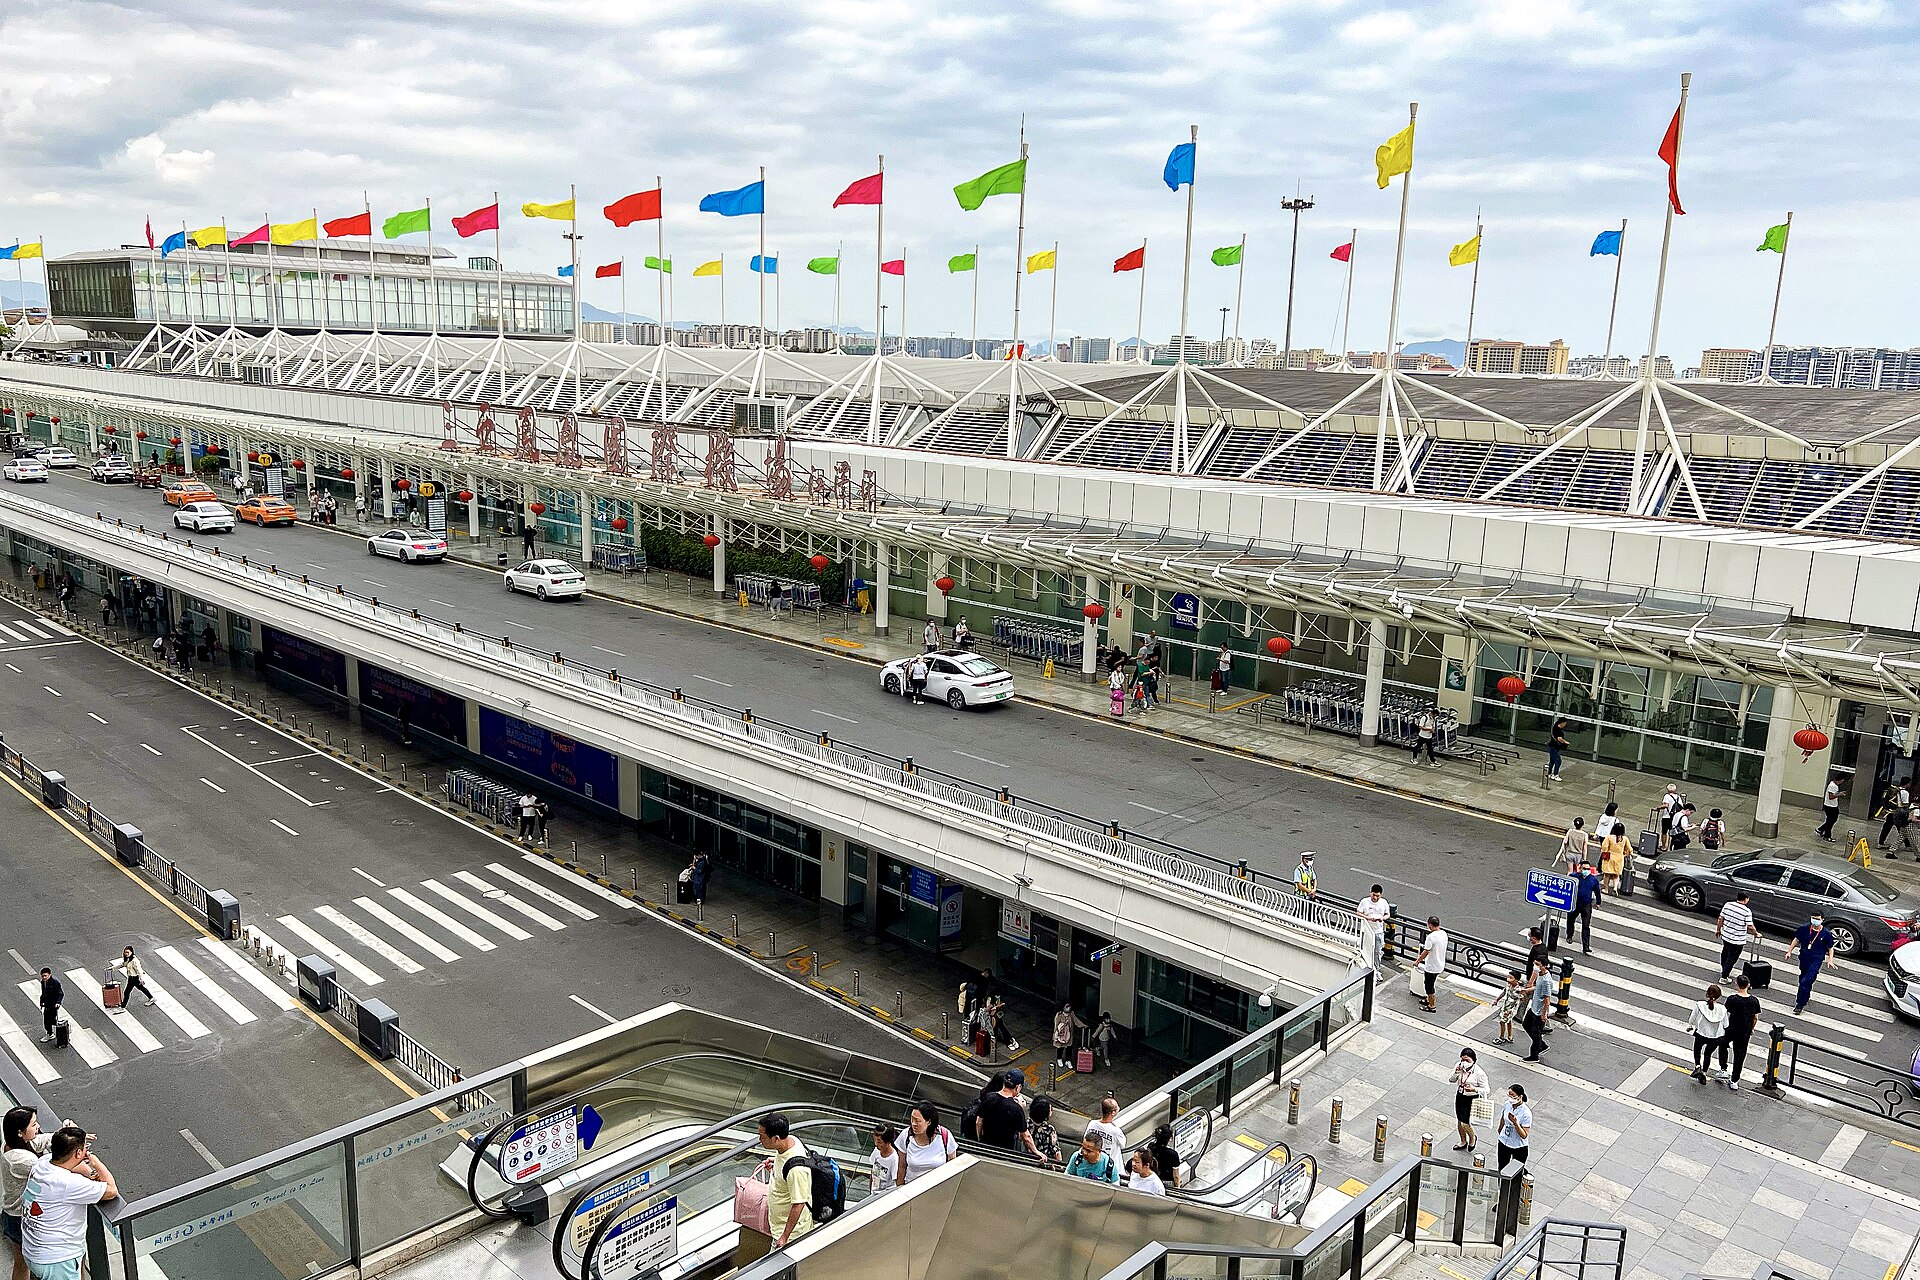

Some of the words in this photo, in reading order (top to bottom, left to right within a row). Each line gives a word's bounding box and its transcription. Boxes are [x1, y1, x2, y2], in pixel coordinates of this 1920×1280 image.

[1530, 873, 1572, 891] 请绕行4号门
[447, 1118, 468, 1133] Travel
[250, 1200, 260, 1209] To
[263, 1189, 287, 1209] Travel
[289, 1185, 298, 1194] is
[299, 1182, 308, 1191] to
[309, 1176, 325, 1188] Live
